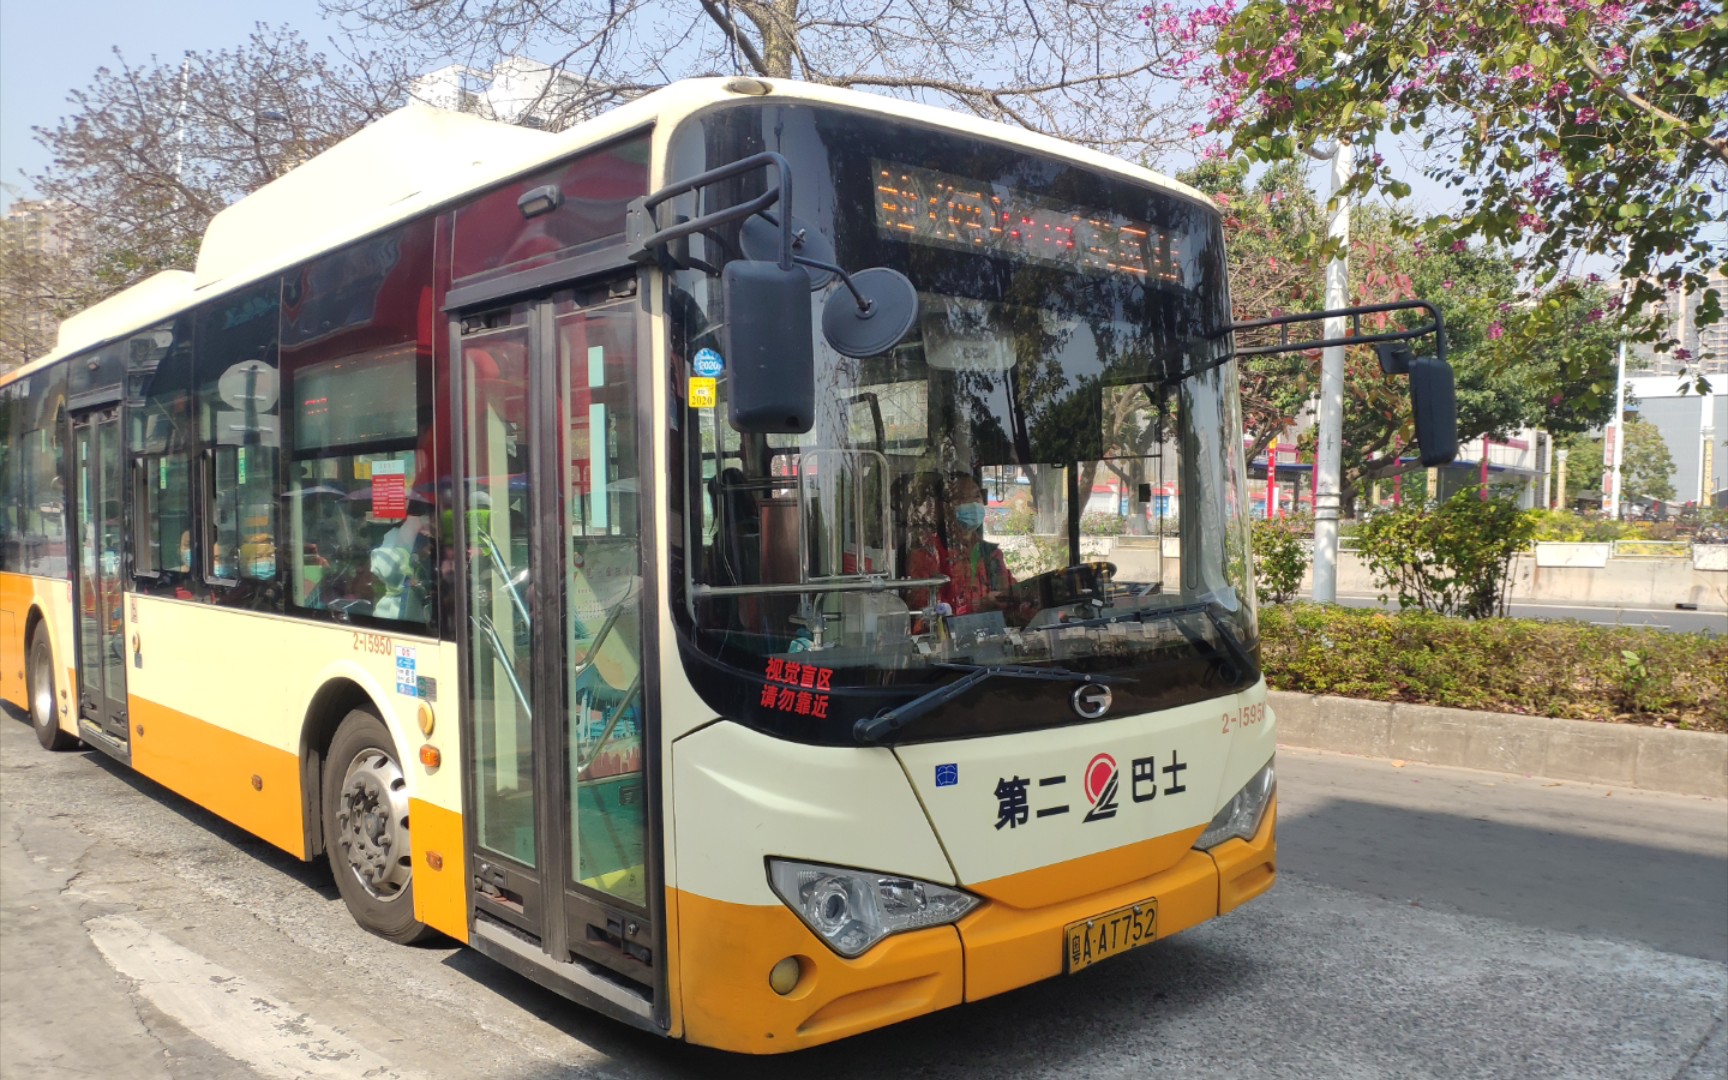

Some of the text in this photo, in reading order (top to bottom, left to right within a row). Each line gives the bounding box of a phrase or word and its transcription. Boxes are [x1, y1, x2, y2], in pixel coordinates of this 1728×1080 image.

[691, 395, 713, 406] 2020
[353, 631, 392, 656] 2-15950
[765, 656, 833, 691] 视觉盲区
[761, 683, 829, 718] 请勿靠近
